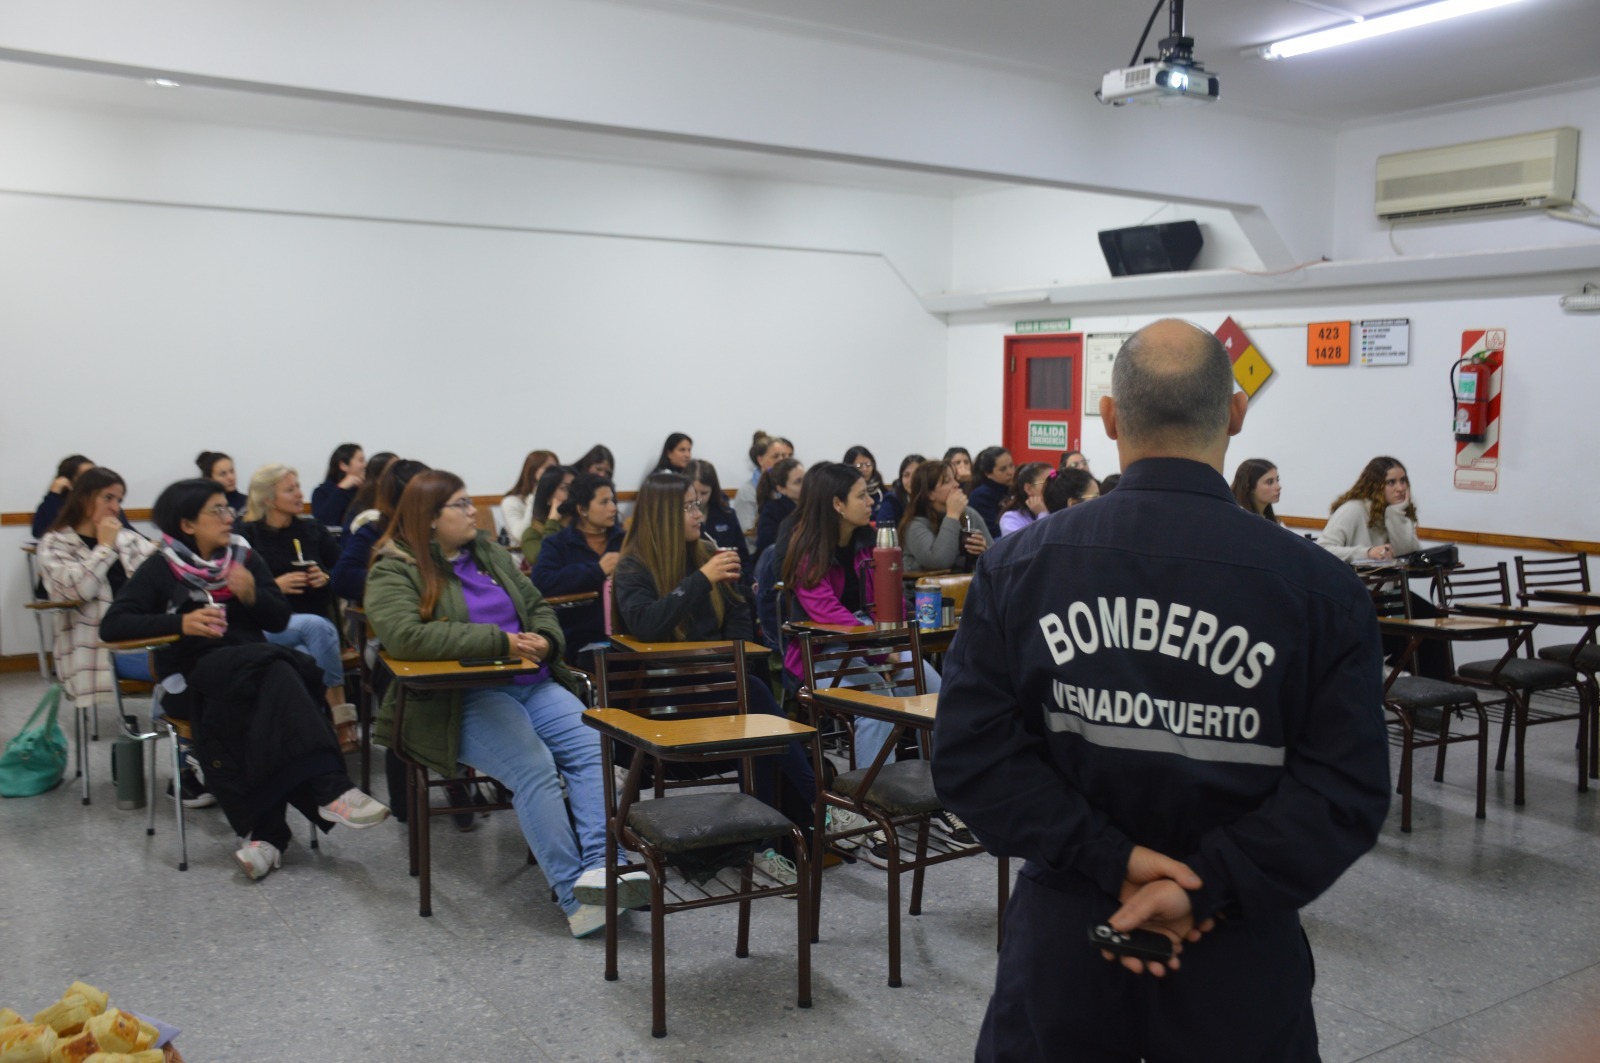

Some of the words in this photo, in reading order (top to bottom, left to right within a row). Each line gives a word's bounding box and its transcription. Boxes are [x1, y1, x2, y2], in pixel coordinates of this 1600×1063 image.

[1318, 327, 1340, 340] 423
[1225, 336, 1233, 349] 4
[1315, 345, 1342, 360] 1428
[1249, 364, 1254, 376] 1
[1031, 425, 1065, 437] SALIDA
[1038, 596, 1276, 689] BOMBEROS
[1053, 678, 1154, 727] VENADO
[1153, 698, 1261, 740] TUERTO
